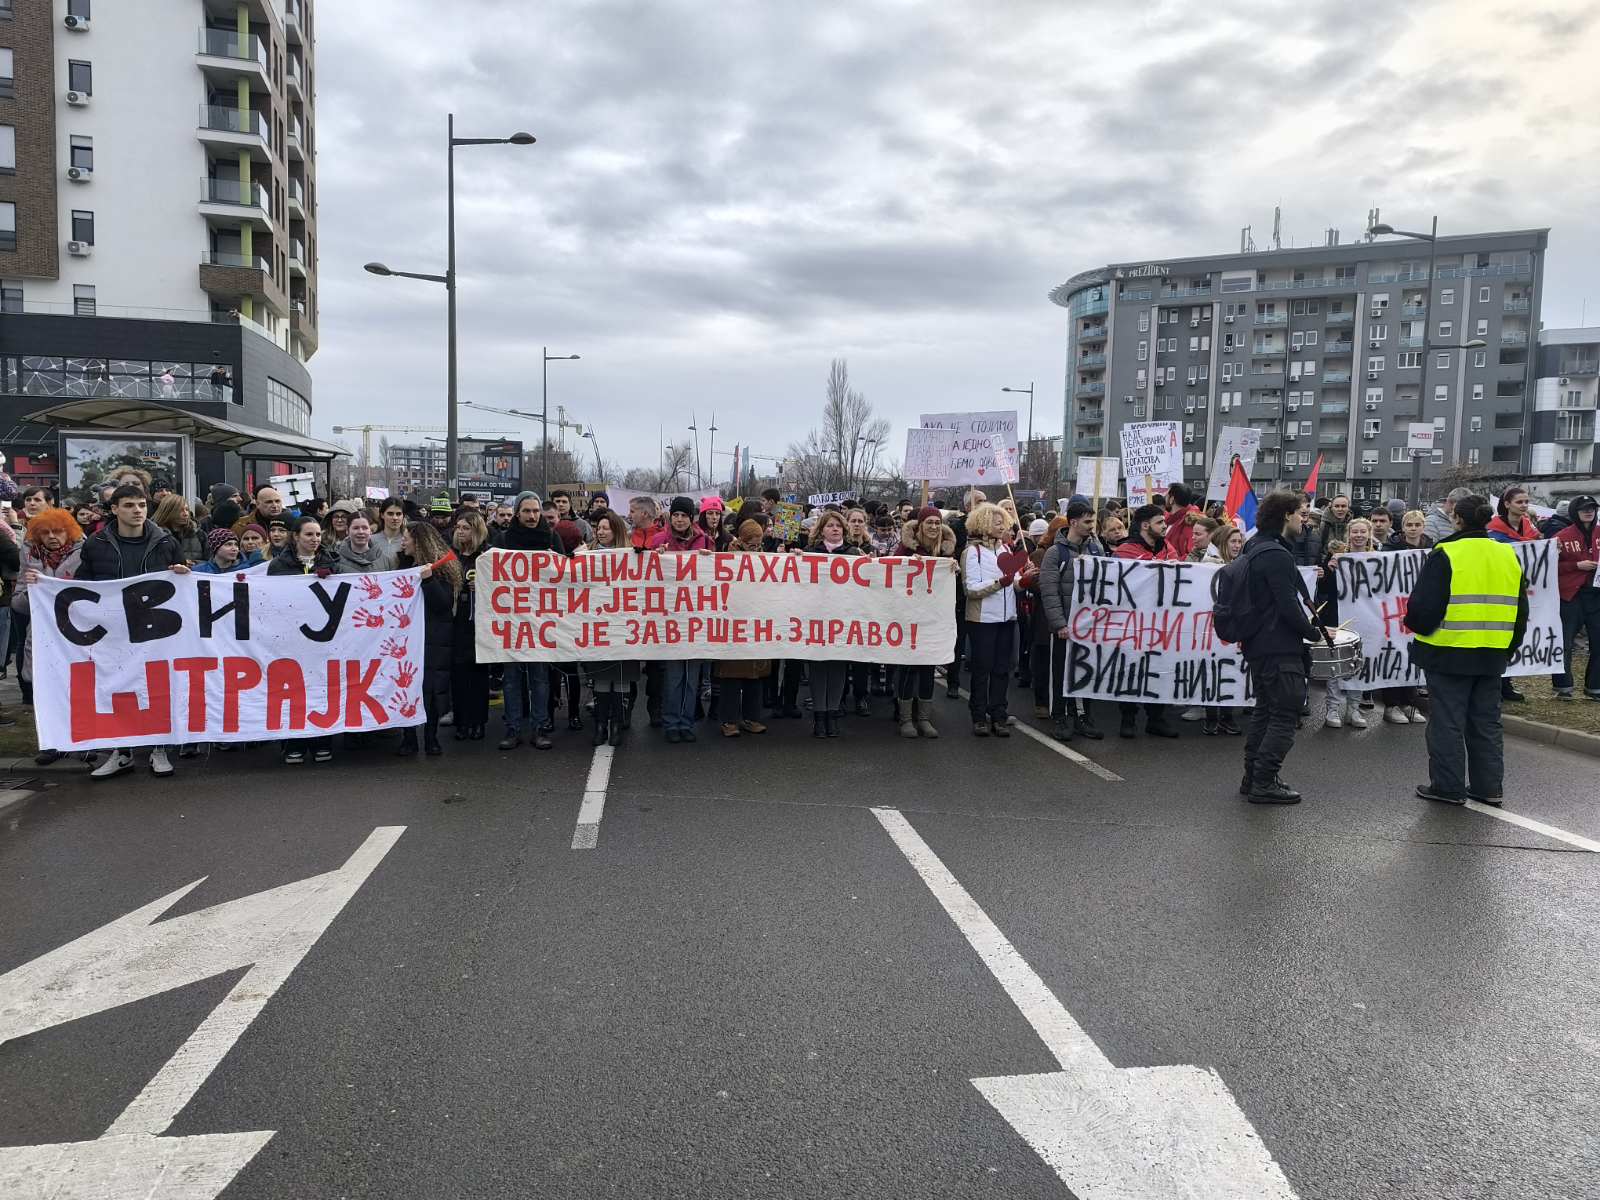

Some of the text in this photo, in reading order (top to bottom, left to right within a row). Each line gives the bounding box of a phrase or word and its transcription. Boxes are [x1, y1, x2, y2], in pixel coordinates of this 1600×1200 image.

[1128, 264, 1170, 278] PREZIDENT
[492, 552, 937, 596] КОРУПЦИЈА И БАХАТОСТ?!
[1076, 557, 1141, 609] НЕК
[1144, 563, 1193, 608] ТЕ
[54, 579, 353, 647] СВИ У
[491, 620, 557, 650] ЧАС
[574, 620, 610, 648] ЈЕ
[788, 616, 919, 651] ЗДРАВО!
[1071, 606, 1184, 653] СРЕДЊИ
[1066, 643, 1162, 699] ВИШЕ
[1173, 652, 1237, 703] НИЈЕ
[70, 656, 390, 743] ШТРАЈК
